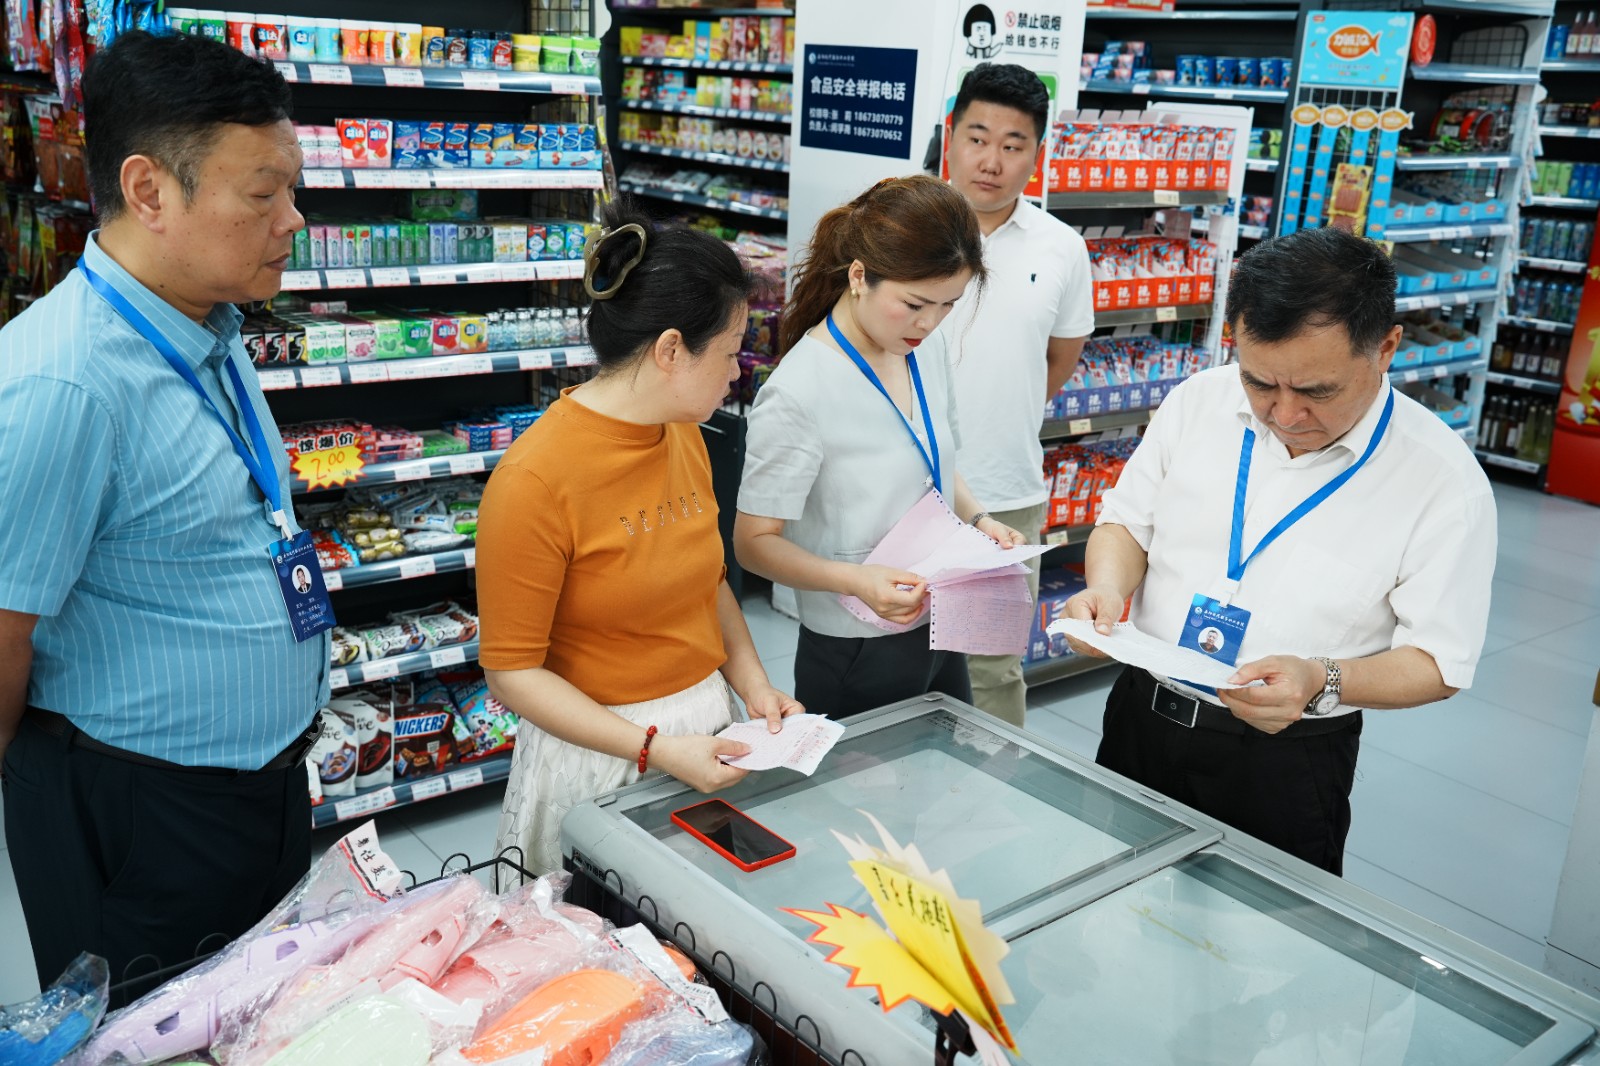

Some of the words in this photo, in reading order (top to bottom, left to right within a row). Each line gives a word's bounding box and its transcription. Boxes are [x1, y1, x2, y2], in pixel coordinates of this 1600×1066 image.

[1017, 12, 1061, 31] 禁止吸烟
[1005, 33, 1060, 50] 给钱也不行
[810, 75, 907, 101] 食品安全举报电话
[854, 111, 904, 126] 18673070779
[853, 126, 903, 141] 18673070652
[299, 432, 354, 453] 惊爆价
[310, 450, 345, 480] 2.00
[394, 713, 448, 737] NICKERS
